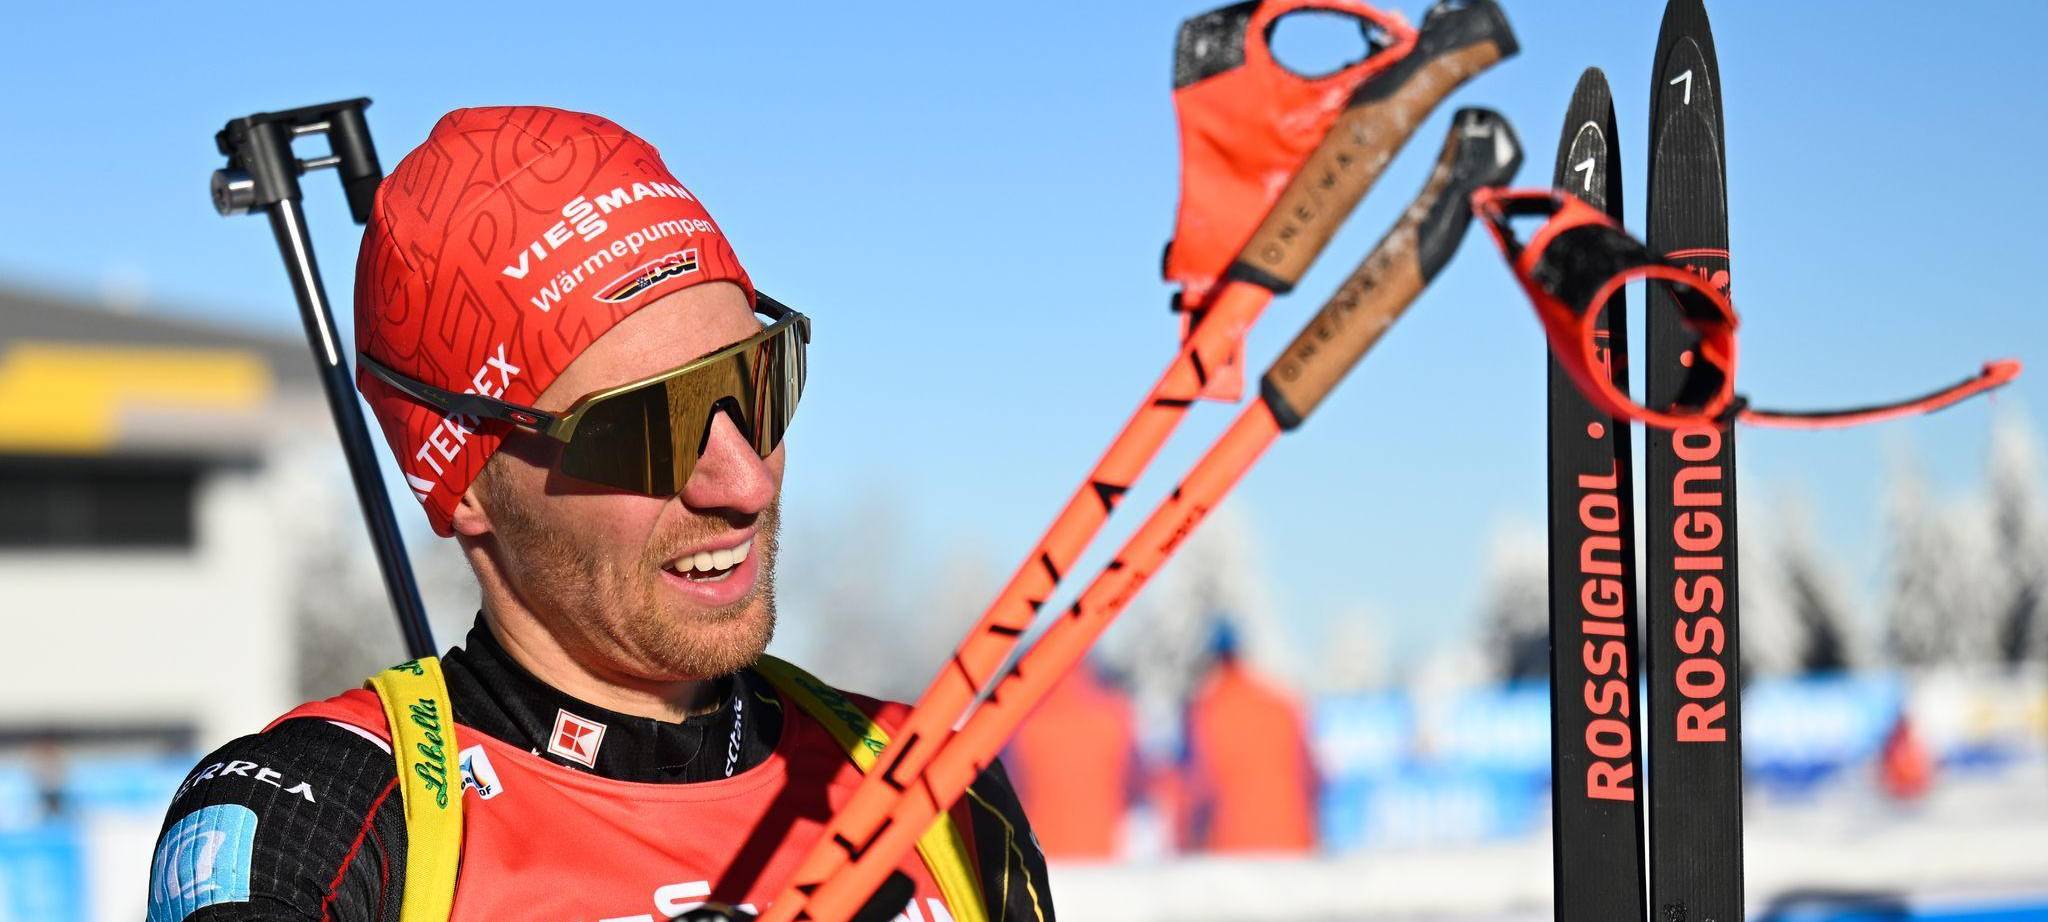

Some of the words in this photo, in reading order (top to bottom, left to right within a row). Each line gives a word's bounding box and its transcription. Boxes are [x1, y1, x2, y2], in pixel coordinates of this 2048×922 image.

[502, 181, 694, 280] VIESSMANN
[530, 217, 717, 314] Wärmepumpen
[649, 248, 699, 281] DSV
[1671, 424, 1728, 743] ROSSIGNO
[408, 697, 449, 810] Libella
